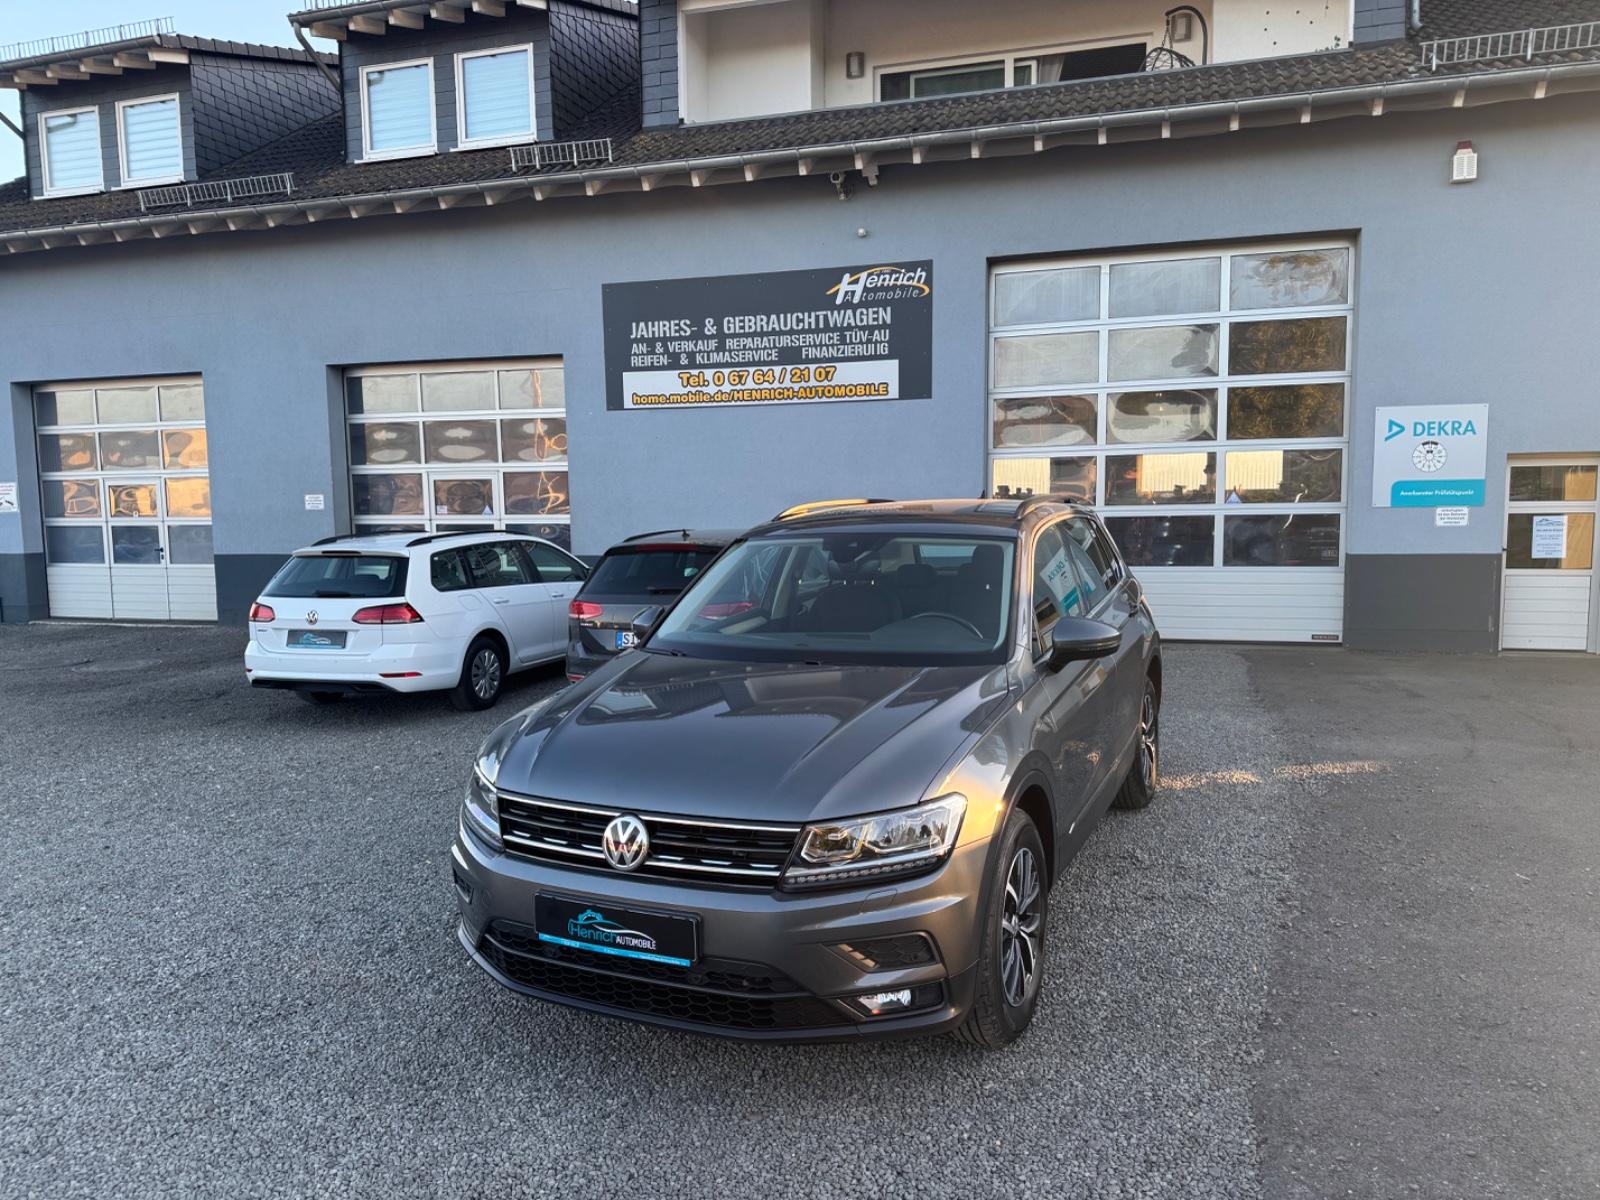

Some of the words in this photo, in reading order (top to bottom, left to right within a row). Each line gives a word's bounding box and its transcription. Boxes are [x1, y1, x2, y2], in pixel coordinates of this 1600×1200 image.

[835, 267, 927, 304] Henrich
[844, 287, 919, 302] Atomobile
[630, 319, 698, 339] JAHRES-
[704, 317, 717, 335] &
[723, 306, 891, 334] GEBRAUCHTWAGEN
[631, 343, 652, 354] AN-
[655, 342, 664, 353] &
[668, 339, 718, 353] VERKAUF
[726, 332, 840, 350] REPARATURSERVICE
[844, 328, 889, 343] TÜV-AU
[631, 354, 672, 367] REIFEN-
[680, 353, 689, 365] &
[696, 348, 778, 364] KLIMASERVICE
[678, 371, 709, 387] Tel.
[713, 371, 725, 386] 0
[728, 368, 749, 385] 67
[753, 367, 775, 384] 64
[779, 367, 787, 383] /
[790, 366, 810, 383] 21
[814, 365, 837, 381] 07
[632, 382, 889, 406] home.mobile.de/HENRICH-AUTOMOBILE
[1413, 420, 1476, 437] DEKRA
[571, 923, 617, 943] Henrich
[616, 935, 657, 950] AUTOMOBILE
